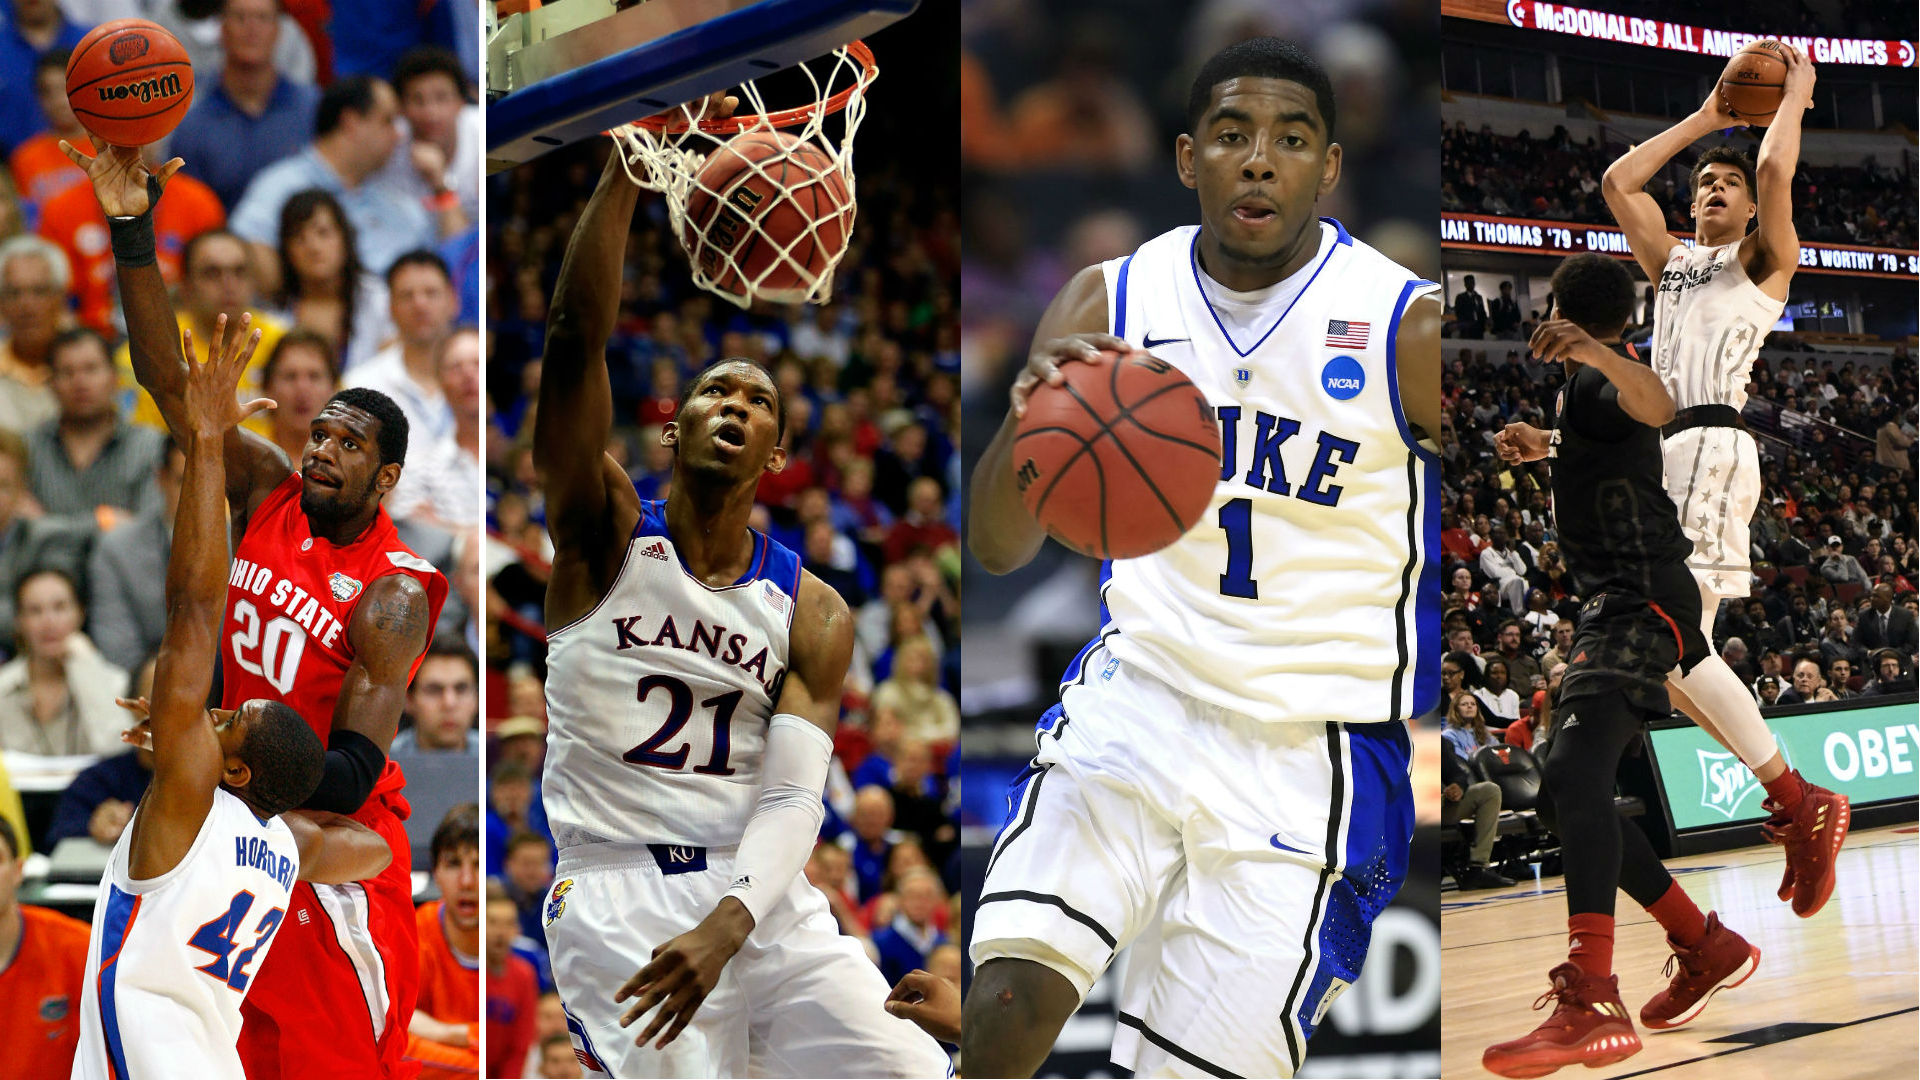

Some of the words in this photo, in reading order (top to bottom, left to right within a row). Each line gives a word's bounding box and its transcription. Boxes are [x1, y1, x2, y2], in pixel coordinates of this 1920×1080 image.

[1534, 2, 1659, 47] McDONALDS
[1662, 22, 1700, 53] ALL
[1813, 36, 1889, 66] GAMES
[97, 72, 183, 104] Wilson
[1474, 221, 1543, 248] THOMAS
[1820, 248, 1875, 271] WORTHY
[1907, 255, 1919, 274] S
[1327, 377, 1360, 391] NCAA
[1210, 405, 1361, 508] UKE
[640, 549, 669, 563] adidas
[1218, 497, 1259, 601] 1
[270, 578, 344, 650] STATE
[231, 598, 308, 697] 20
[622, 674, 745, 776] 21
[667, 846, 696, 864] KU
[186, 888, 286, 995] 42
